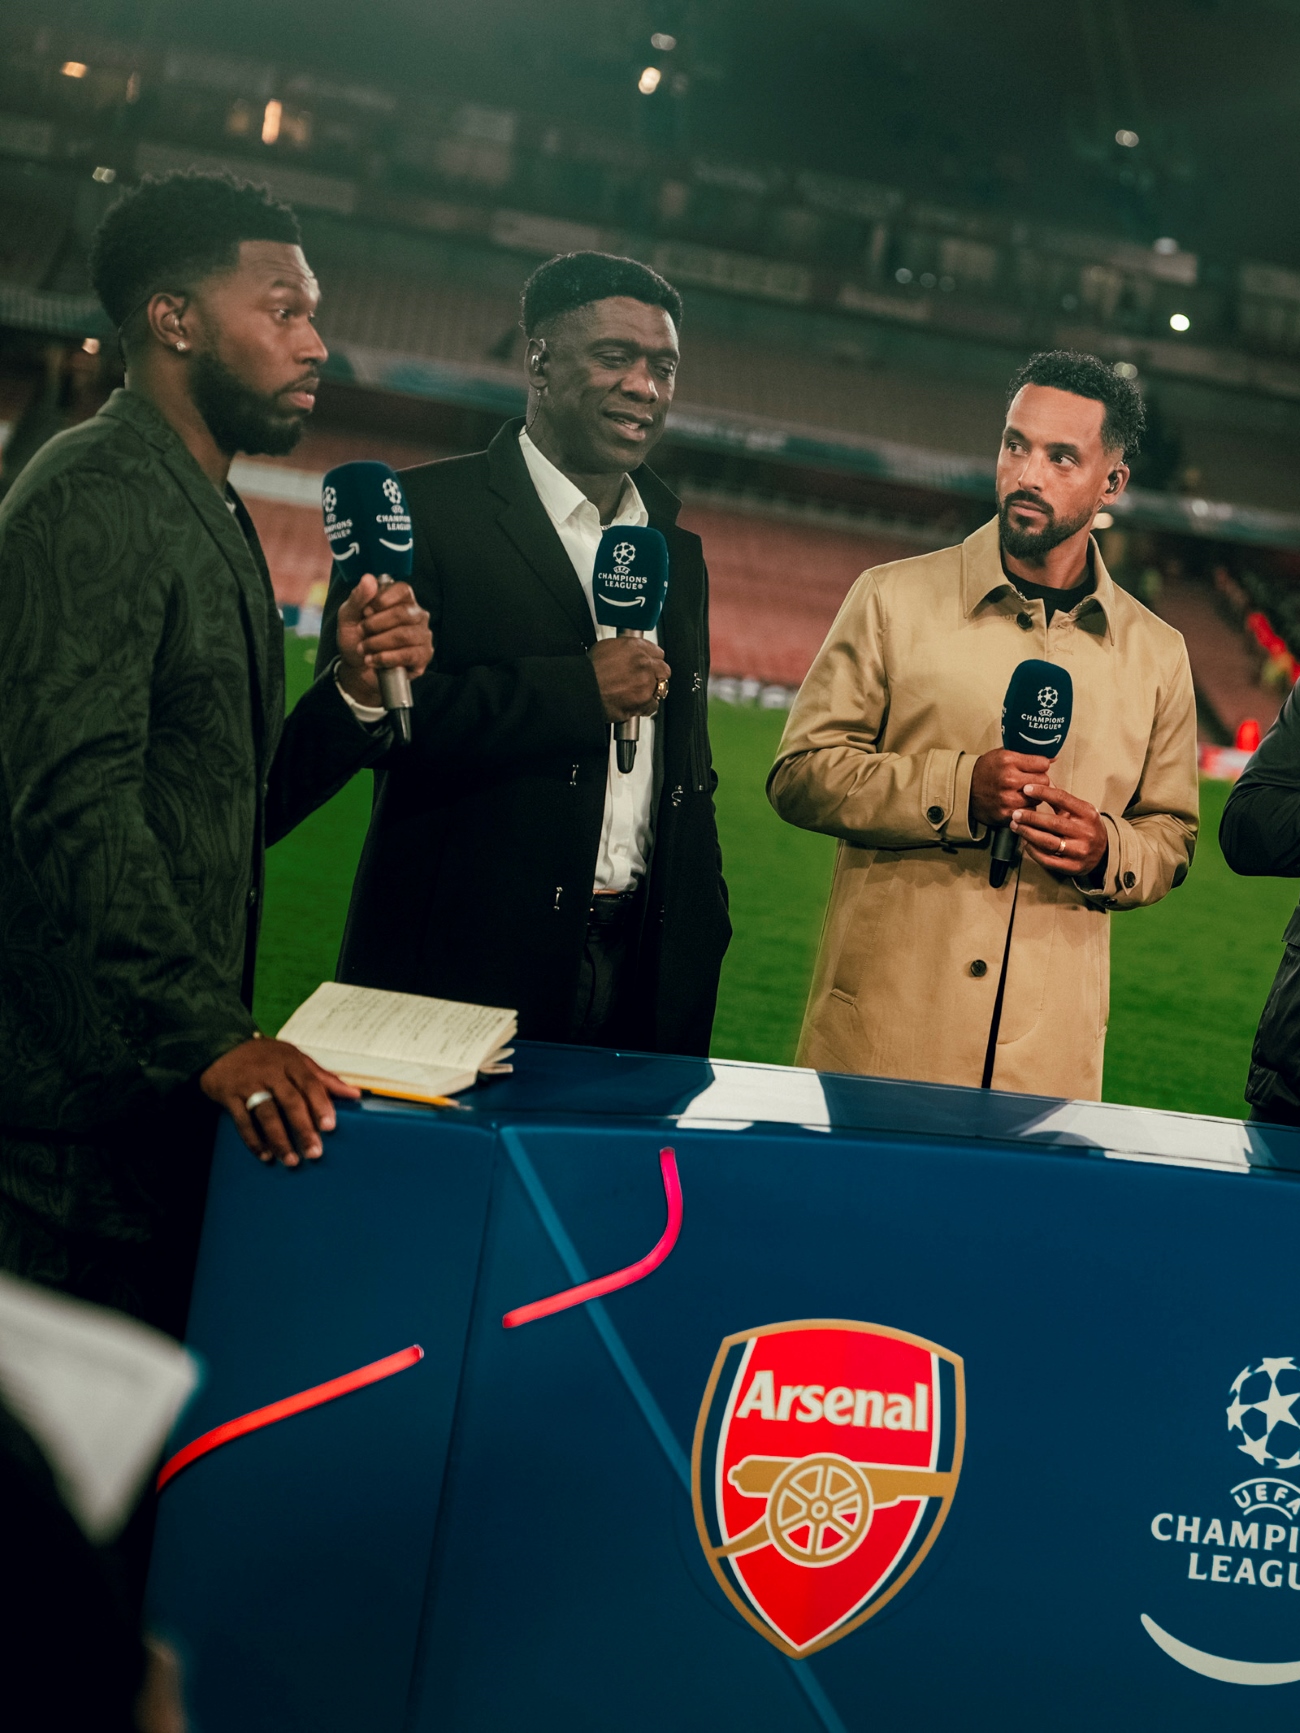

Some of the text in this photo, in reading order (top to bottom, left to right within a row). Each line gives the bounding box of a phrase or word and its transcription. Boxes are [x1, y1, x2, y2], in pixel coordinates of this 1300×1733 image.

[598, 572, 648, 584] CHAMPIONS
[1021, 713, 1065, 724] CHAMPIONS
[735, 1369, 929, 1432] Arsenal
